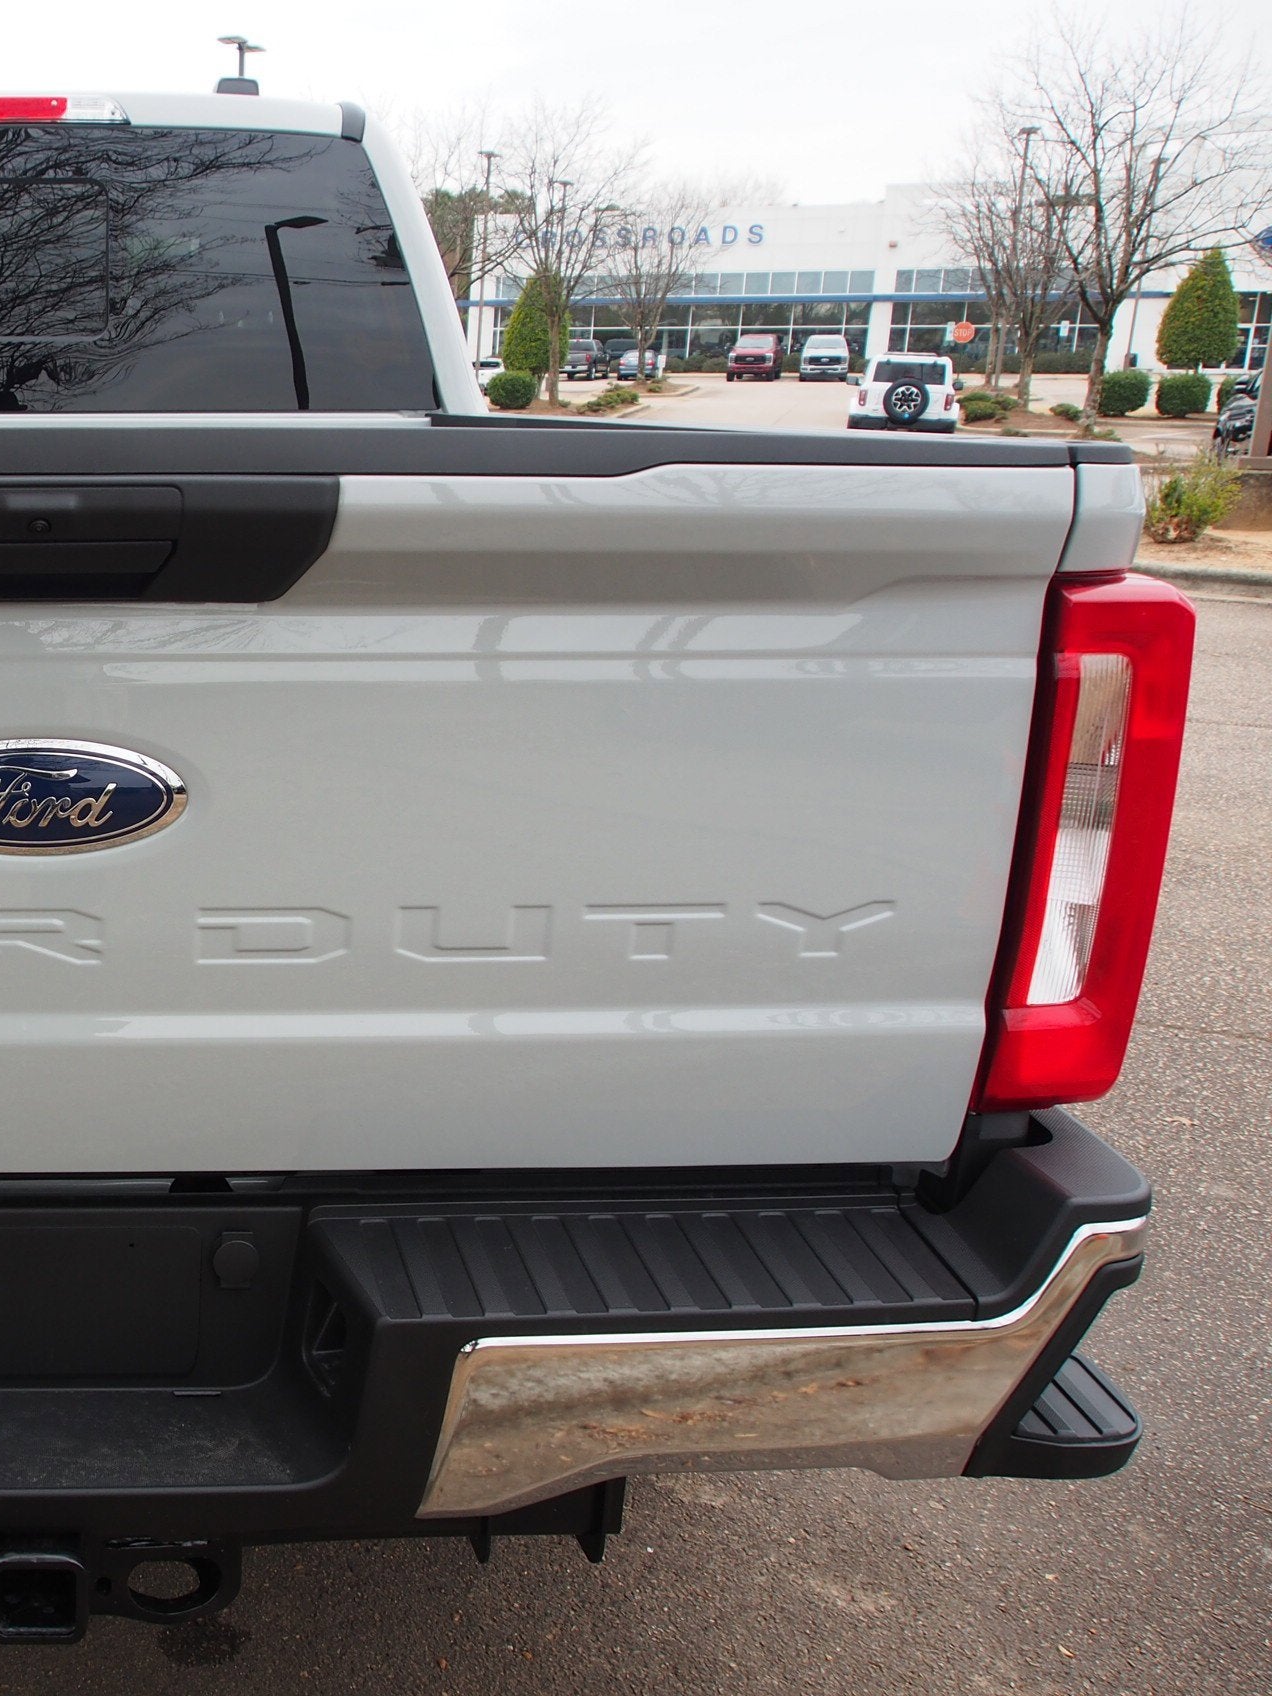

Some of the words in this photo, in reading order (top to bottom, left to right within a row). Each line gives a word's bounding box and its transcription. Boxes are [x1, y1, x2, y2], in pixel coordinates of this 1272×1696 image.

[514, 223, 765, 250] CROSSROADS
[953, 328, 973, 338] STOP
[195, 900, 896, 964] DUTY
